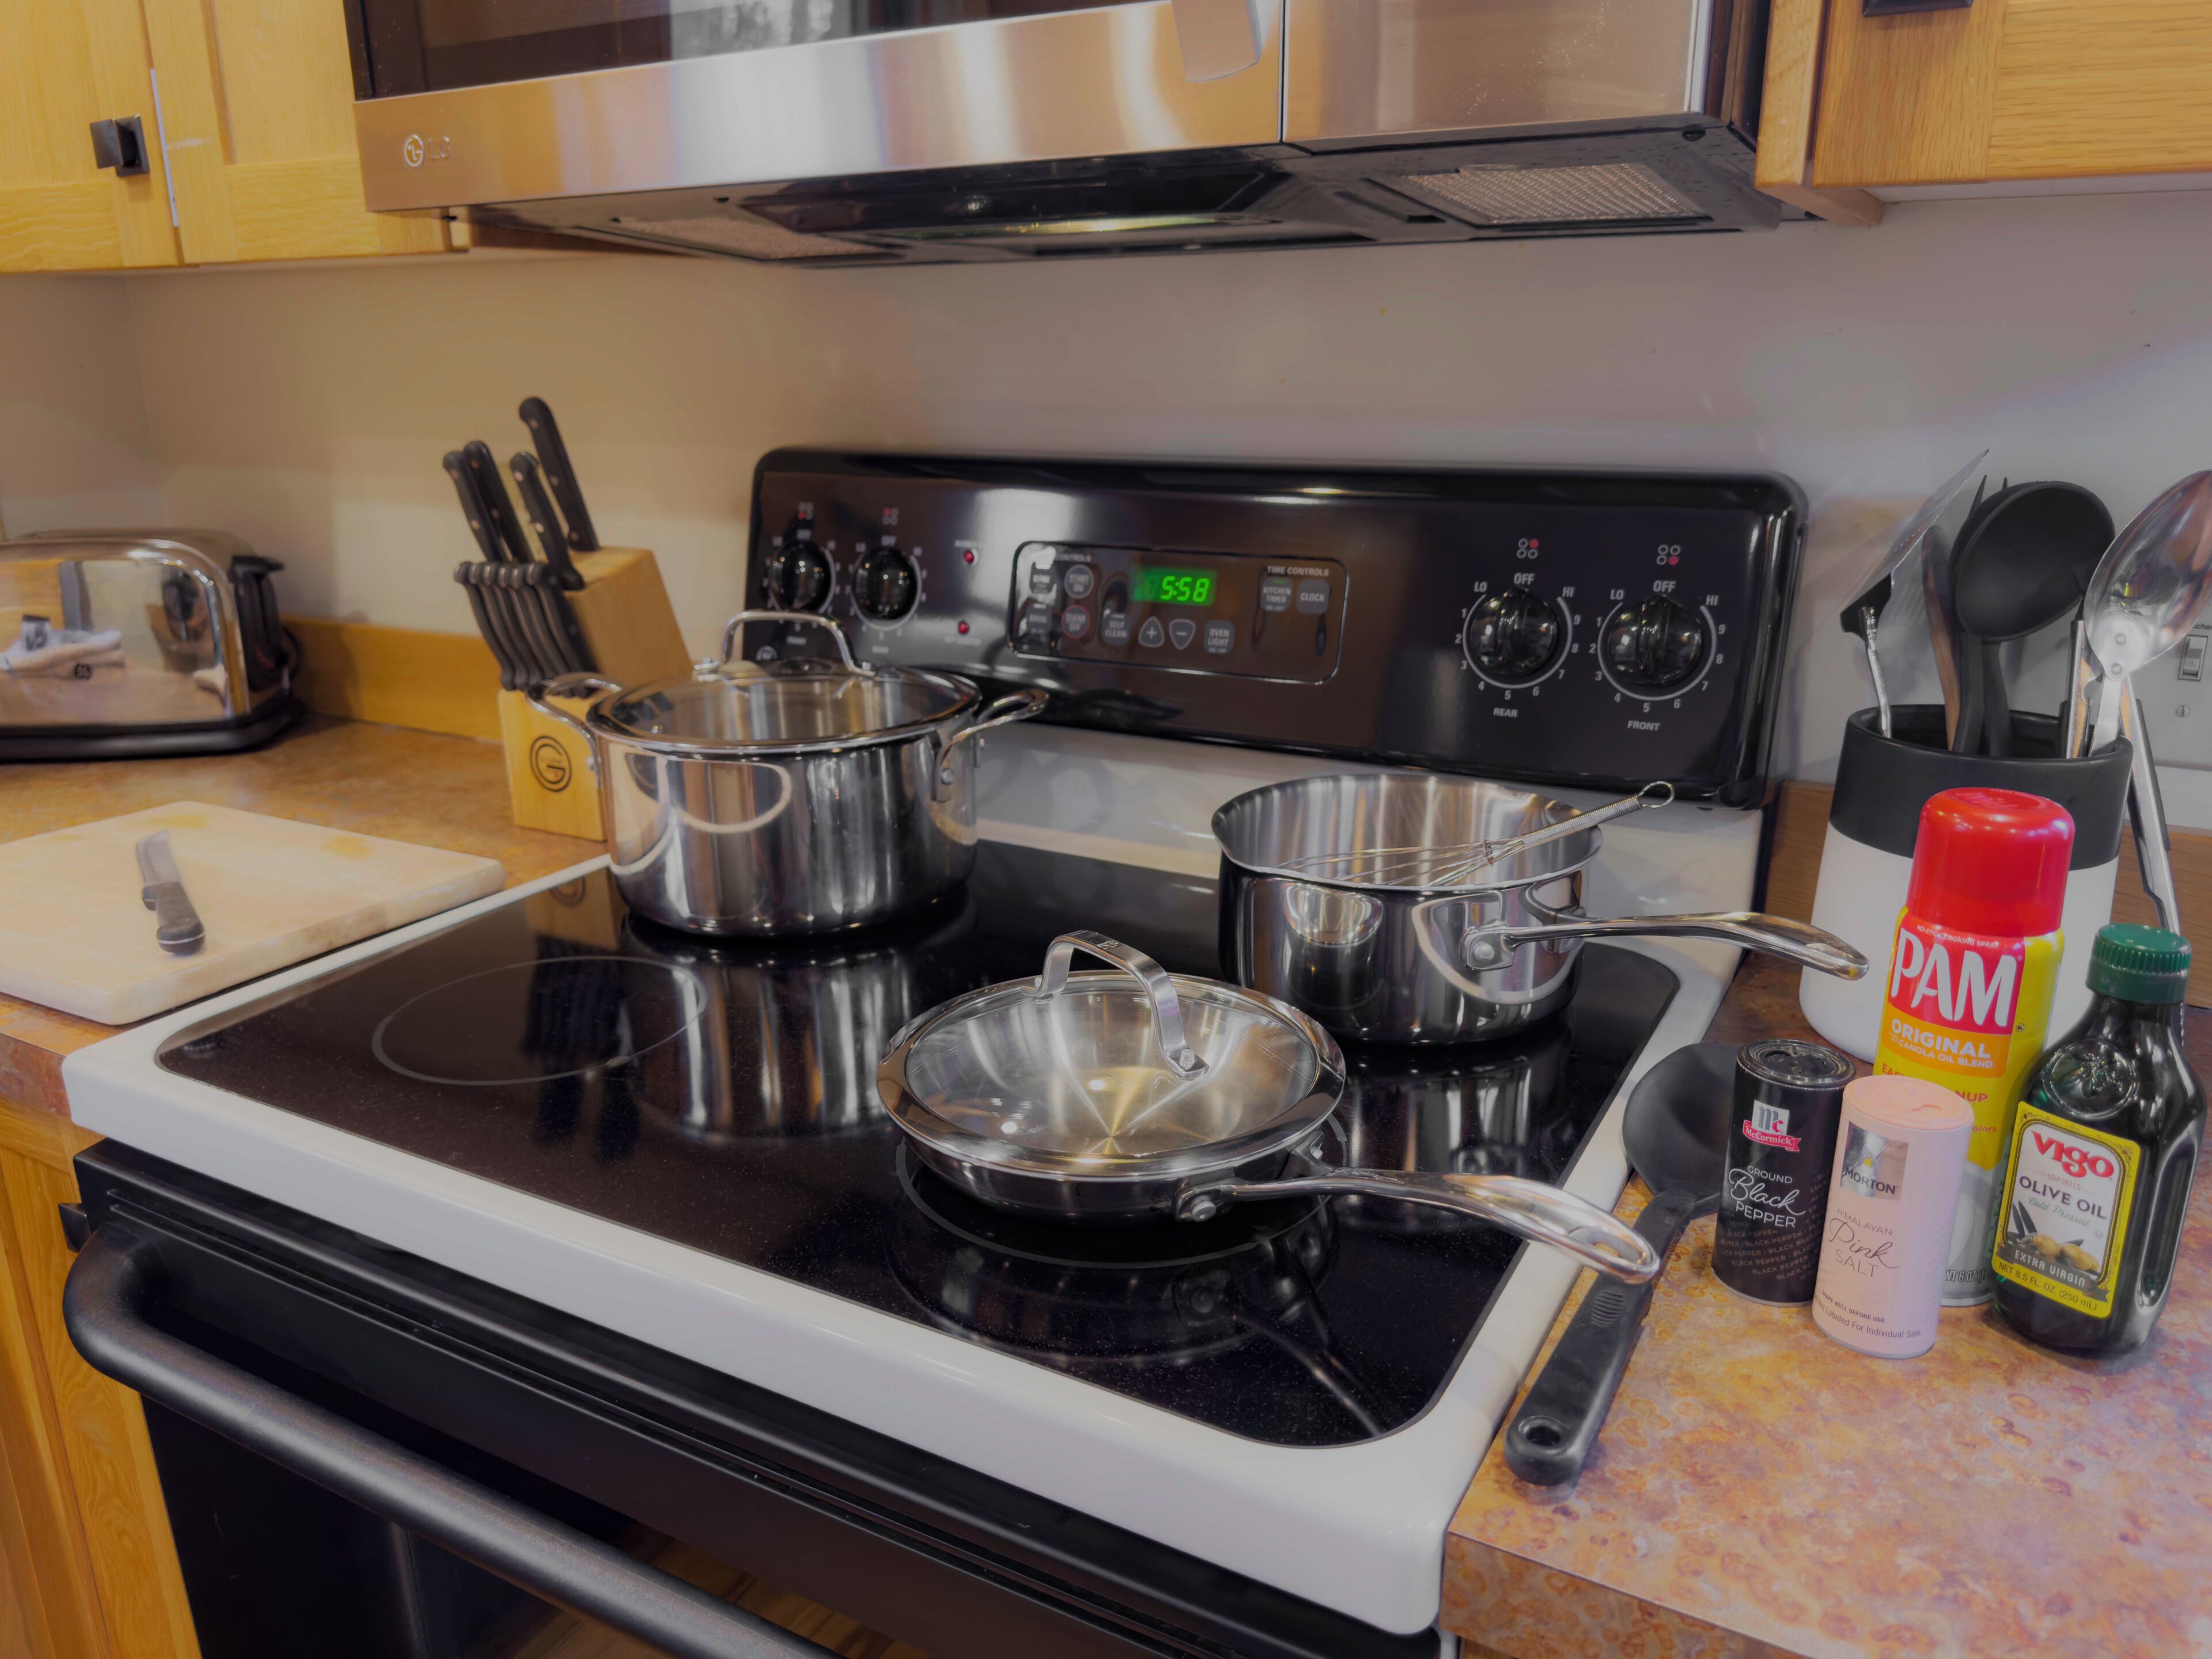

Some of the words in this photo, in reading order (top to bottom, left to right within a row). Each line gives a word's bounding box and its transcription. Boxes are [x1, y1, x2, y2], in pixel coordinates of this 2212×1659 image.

[1267, 566, 1285, 574] TIME
[1287, 567, 1329, 576] CONTROLS
[1069, 573, 1090, 583] START
[1513, 573, 1535, 585] OFF
[1161, 575, 1210, 603] 5:58
[1263, 586, 1291, 596] KITCHEN
[1474, 581, 1487, 592] LO
[1562, 586, 1574, 597] HI
[1653, 580, 1676, 592] OFF
[1266, 595, 1287, 604] TIMER
[1300, 593, 1325, 602] CLOCK
[1610, 589, 1624, 600] LO
[1706, 595, 1718, 606] HI
[1066, 613, 1086, 622] CLEAR
[1461, 608, 1467, 618] 1
[1109, 620, 1124, 628] SELF
[1574, 615, 1581, 625] 9
[1596, 616, 1602, 627] 1
[1105, 629, 1127, 638] CLEAN
[1210, 628, 1229, 638] OVEN
[1718, 624, 1726, 634] 9
[1208, 638, 1229, 646] LIGHT
[1455, 634, 1461, 644] 2
[1571, 643, 1578, 653] 8
[1589, 643, 1596, 653] 2
[1716, 654, 1723, 664] 8
[1461, 660, 1467, 670] 3
[1558, 669, 1565, 679] 7
[1595, 671, 1602, 681] 3
[1478, 681, 1484, 691] 4
[1532, 687, 1540, 696] 6
[1701, 681, 1708, 691] 7
[1505, 691, 1512, 700] 5
[1614, 693, 1621, 703] 4
[1643, 703, 1650, 713] 5
[1673, 699, 1681, 709] 6
[1493, 708, 1518, 717] REAR
[1627, 721, 1660, 731] FRONT
[1916, 925, 1941, 938] NO-STICK
[1943, 933, 1975, 945] COOKING
[1976, 940, 1999, 949] SPRAY
[1891, 927, 2016, 1027] PAM
[1892, 1018, 1991, 1058] ORIGINAL
[1899, 1039, 1935, 1059] CANOLA
[1938, 1053, 1955, 1063] OIL
[1958, 1058, 1994, 1069] BLEND
[1745, 1126, 1793, 1146] McCormick
[1748, 1165, 1793, 1184] GROUND
[1844, 1166, 1896, 1195] MORTON
[2047, 1172, 2081, 1192] IMPORTED
[1729, 1168, 1806, 1215] Black
[2019, 1175, 2071, 1206] OLIVE
[2077, 1198, 2107, 1219] OIL
[1736, 1200, 1797, 1228] PEPPER
[2028, 1195, 2049, 1211] Cold
[2054, 1205, 2091, 1227] Pressed
[1838, 1207, 1893, 1236] HIMALAYAN
[1768, 1243, 1793, 1254] BLACK
[1828, 1218, 1900, 1269] Pink
[1751, 1267, 1779, 1275] BLACK
[1779, 1255, 1809, 1271] PEPPER
[1755, 1255, 1787, 1265] PEPPER
[1835, 1249, 1879, 1277] SALT
[2015, 1249, 2045, 1271] EXTRA
[2049, 1263, 2085, 1288] VIRGIN
[1776, 1268, 1801, 1281] BLACK
[1959, 1270, 1965, 1282] 6
[1966, 1270, 1977, 1282] OZ
[1999, 1261, 2014, 1275] NET
[2015, 1268, 2028, 1283] 8.5
[2029, 1275, 2041, 1288] FL.
[2044, 1283, 2056, 1294] OZ.
[2059, 1288, 2078, 1304] (250
[1822, 1290, 1834, 1303] SHAKE
[1834, 1300, 1847, 1312] WELL
[1849, 1308, 1872, 1320] BEFORE
[1825, 1305, 1850, 1327] Labeled
[1851, 1321, 1864, 1332] For
[1866, 1325, 1904, 1339] Individual
[1906, 1330, 1922, 1338] Sale.
